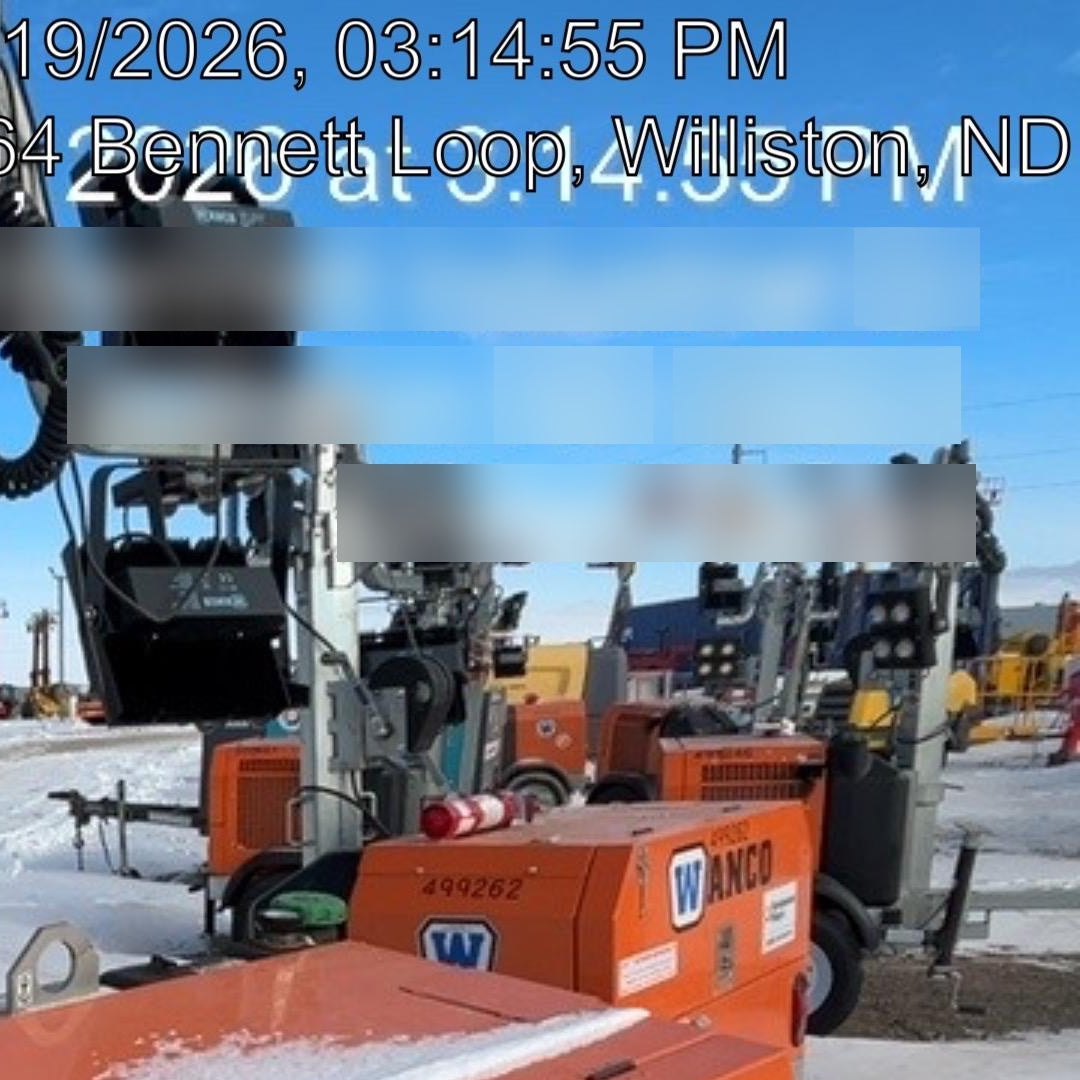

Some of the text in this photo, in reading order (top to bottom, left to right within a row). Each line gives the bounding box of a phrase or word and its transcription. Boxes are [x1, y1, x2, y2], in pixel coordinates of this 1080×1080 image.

[422, 877, 523, 901] 499262
[675, 840, 772, 916] WANCO
[431, 931, 485, 969] W
